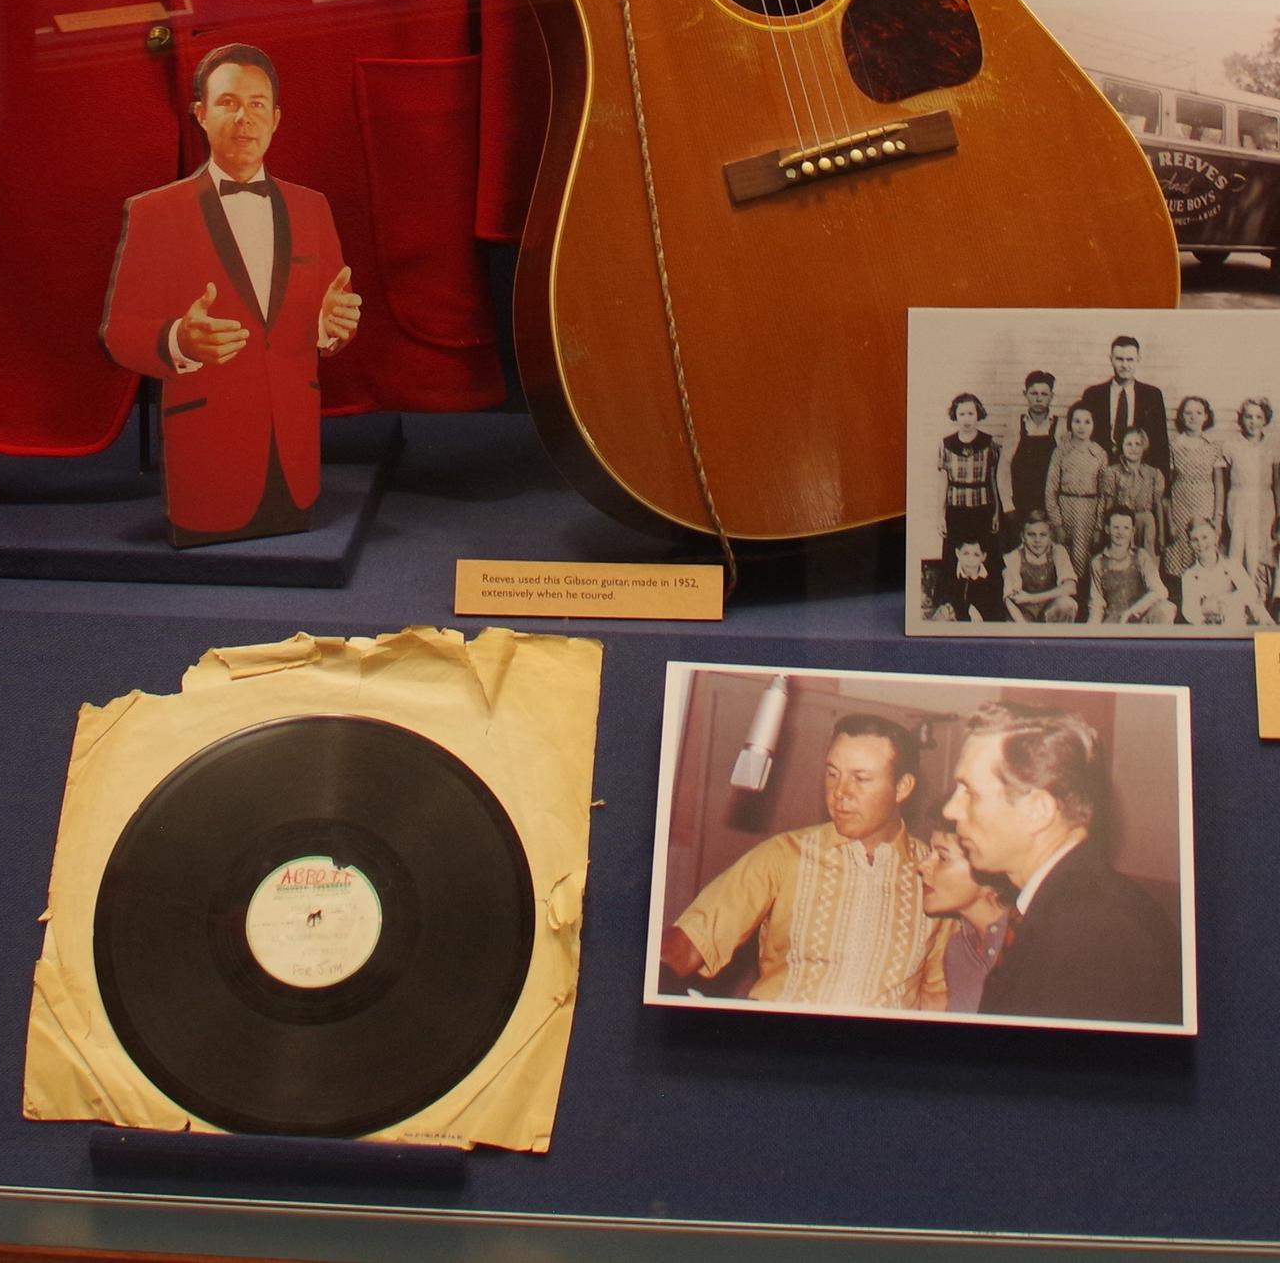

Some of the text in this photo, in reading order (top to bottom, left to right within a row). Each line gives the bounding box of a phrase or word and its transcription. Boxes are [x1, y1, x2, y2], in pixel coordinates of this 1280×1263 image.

[1158, 151, 1229, 191] REEVES
[1186, 189, 1216, 212] BOYS
[482, 573, 700, 589] Reeves used this Gibson guitar, made in 1952,
[481, 589, 616, 601] extensively when he toured.
